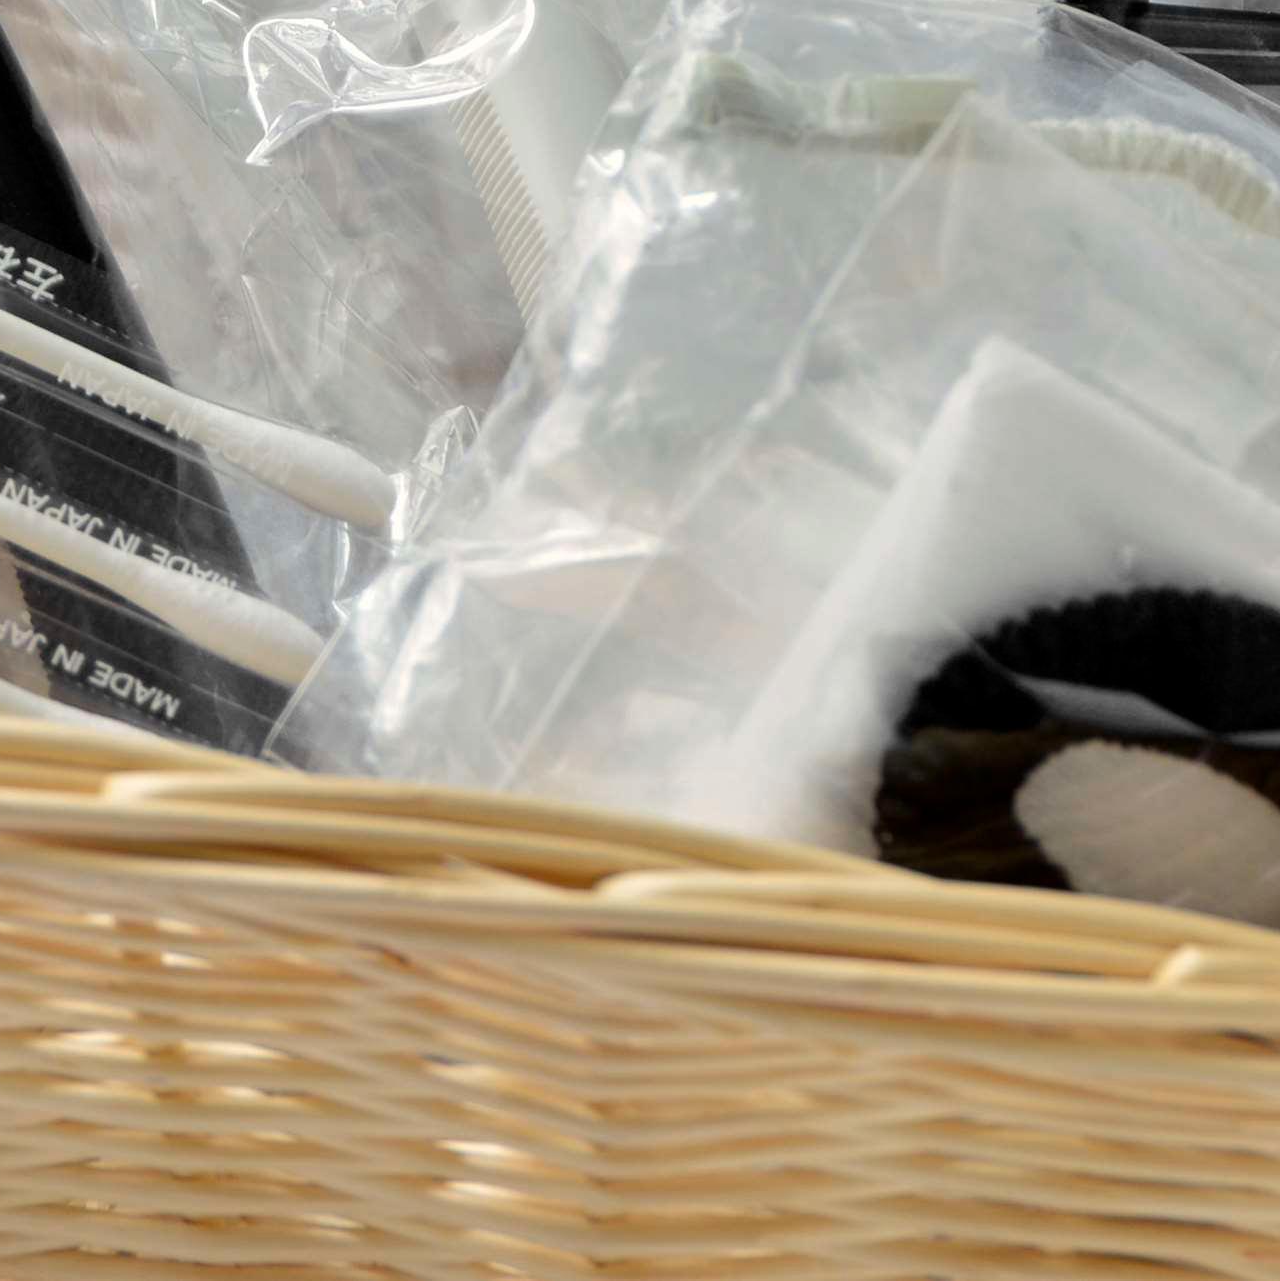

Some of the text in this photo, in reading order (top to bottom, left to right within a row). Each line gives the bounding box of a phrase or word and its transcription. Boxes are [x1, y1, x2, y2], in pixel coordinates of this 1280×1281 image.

[105, 525, 142, 558] IN
[49, 641, 86, 674] IN
[86, 658, 182, 719] MADE
